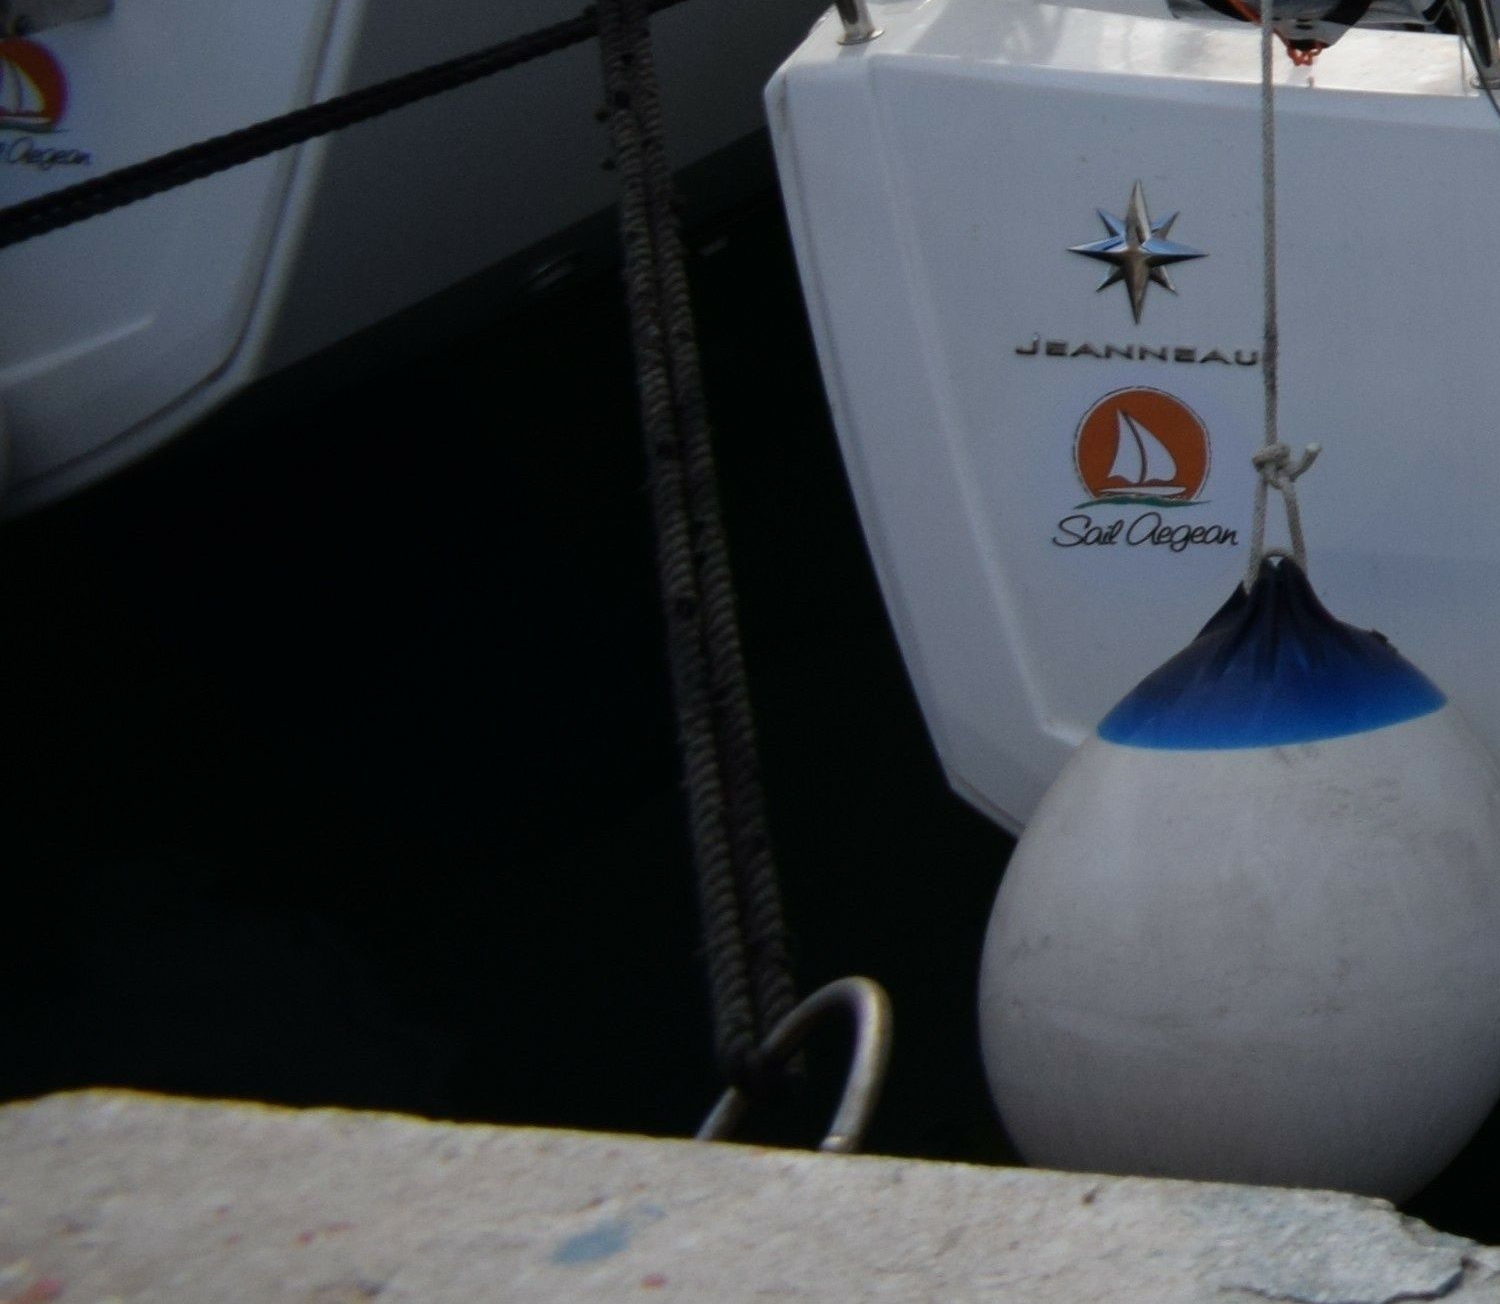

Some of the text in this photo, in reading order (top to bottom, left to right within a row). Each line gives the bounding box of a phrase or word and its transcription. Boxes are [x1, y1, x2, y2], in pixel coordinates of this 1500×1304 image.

[1015, 333, 1259, 366] JEANNEAU
[1053, 511, 1239, 553] Sail Aegean
